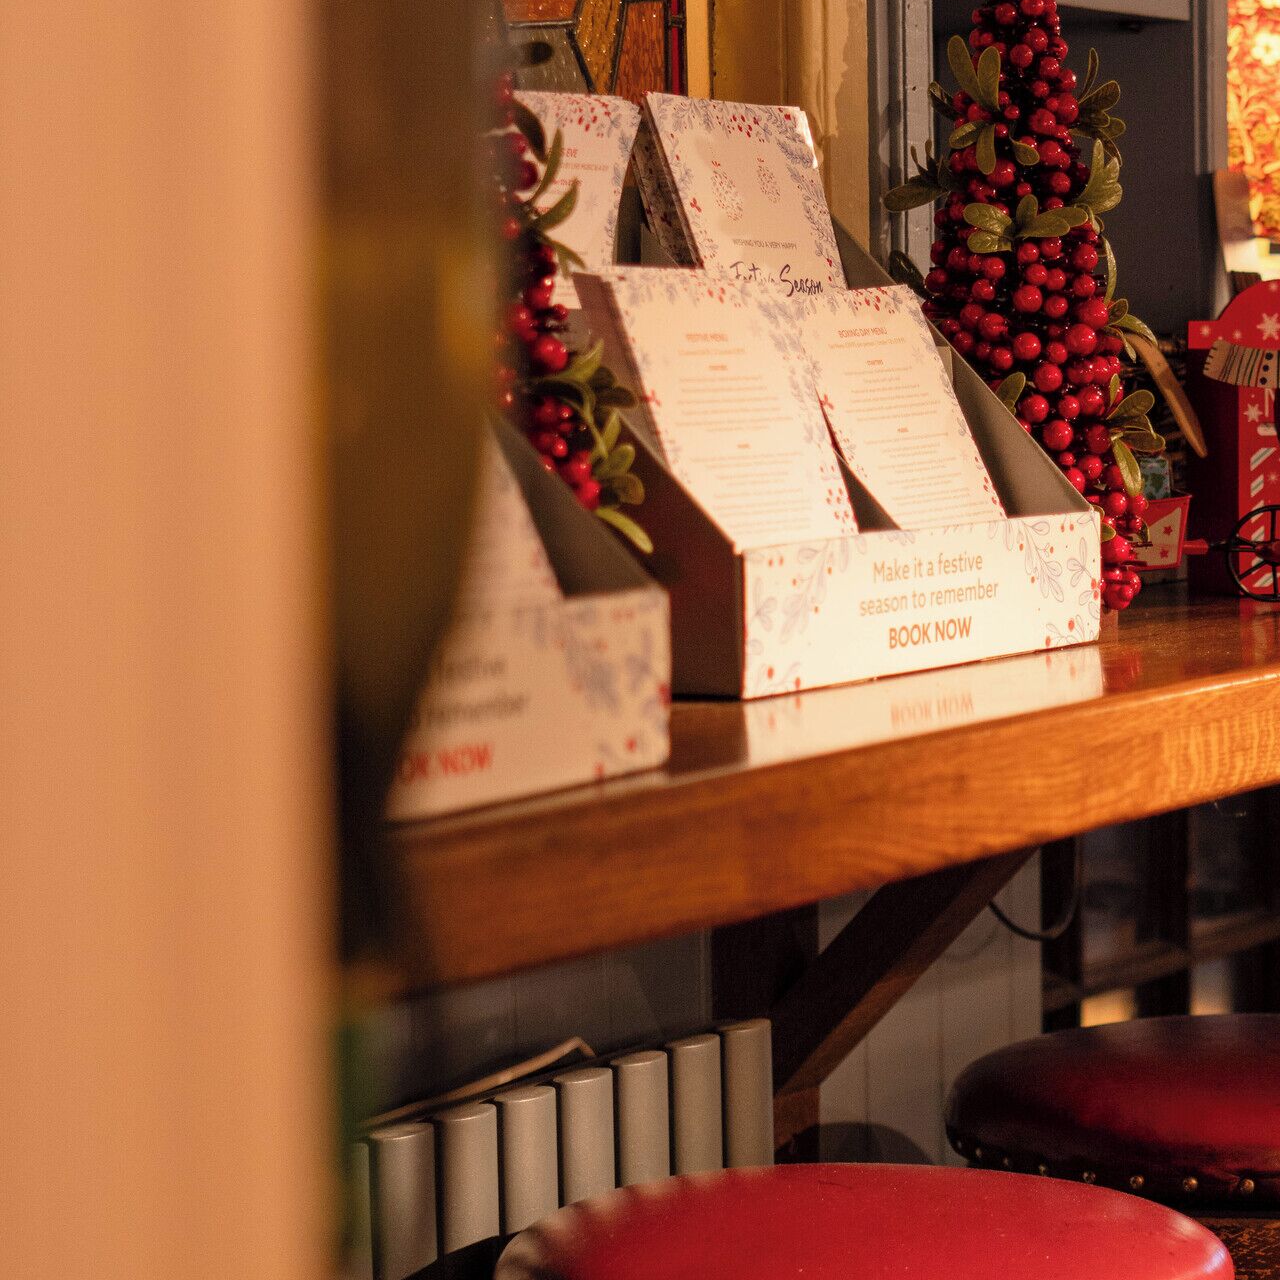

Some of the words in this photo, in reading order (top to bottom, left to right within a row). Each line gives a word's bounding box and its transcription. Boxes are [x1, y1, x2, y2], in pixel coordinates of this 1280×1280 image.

[780, 264, 824, 297] Season
[872, 558, 911, 584] Make
[914, 556, 923, 578] it
[926, 560, 935, 577] a
[938, 552, 983, 576] festive
[860, 593, 908, 617] season
[912, 590, 926, 609] to
[930, 578, 999, 608] remember
[888, 622, 932, 649] BOOK
[934, 616, 972, 642] NOW
